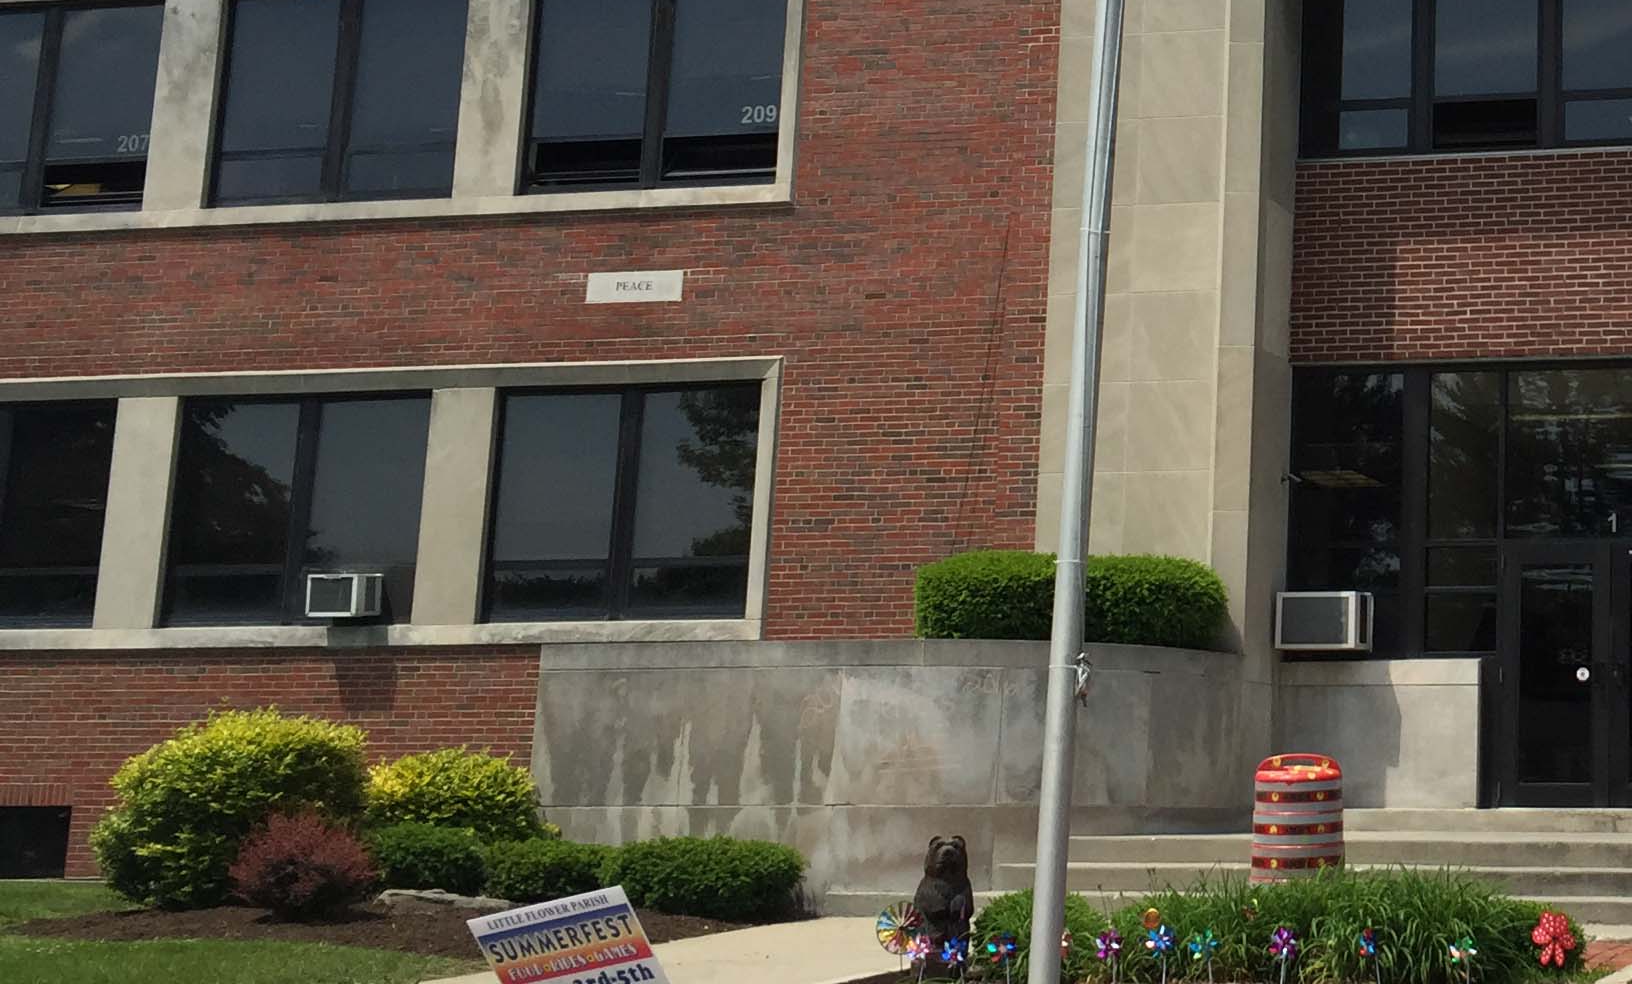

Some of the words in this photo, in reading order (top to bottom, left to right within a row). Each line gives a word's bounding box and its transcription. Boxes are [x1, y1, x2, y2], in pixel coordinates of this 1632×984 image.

[741, 105, 777, 123] 209
[117, 135, 149, 152] 207
[615, 280, 654, 292] PEACE
[1607, 512, 1617, 533] 1
[487, 911, 525, 930] LITTLE
[526, 903, 570, 922] FLOWER
[571, 894, 609, 910] PARISH
[488, 913, 633, 963] SUMMERFEST
[594, 943, 638, 962] GAMES
